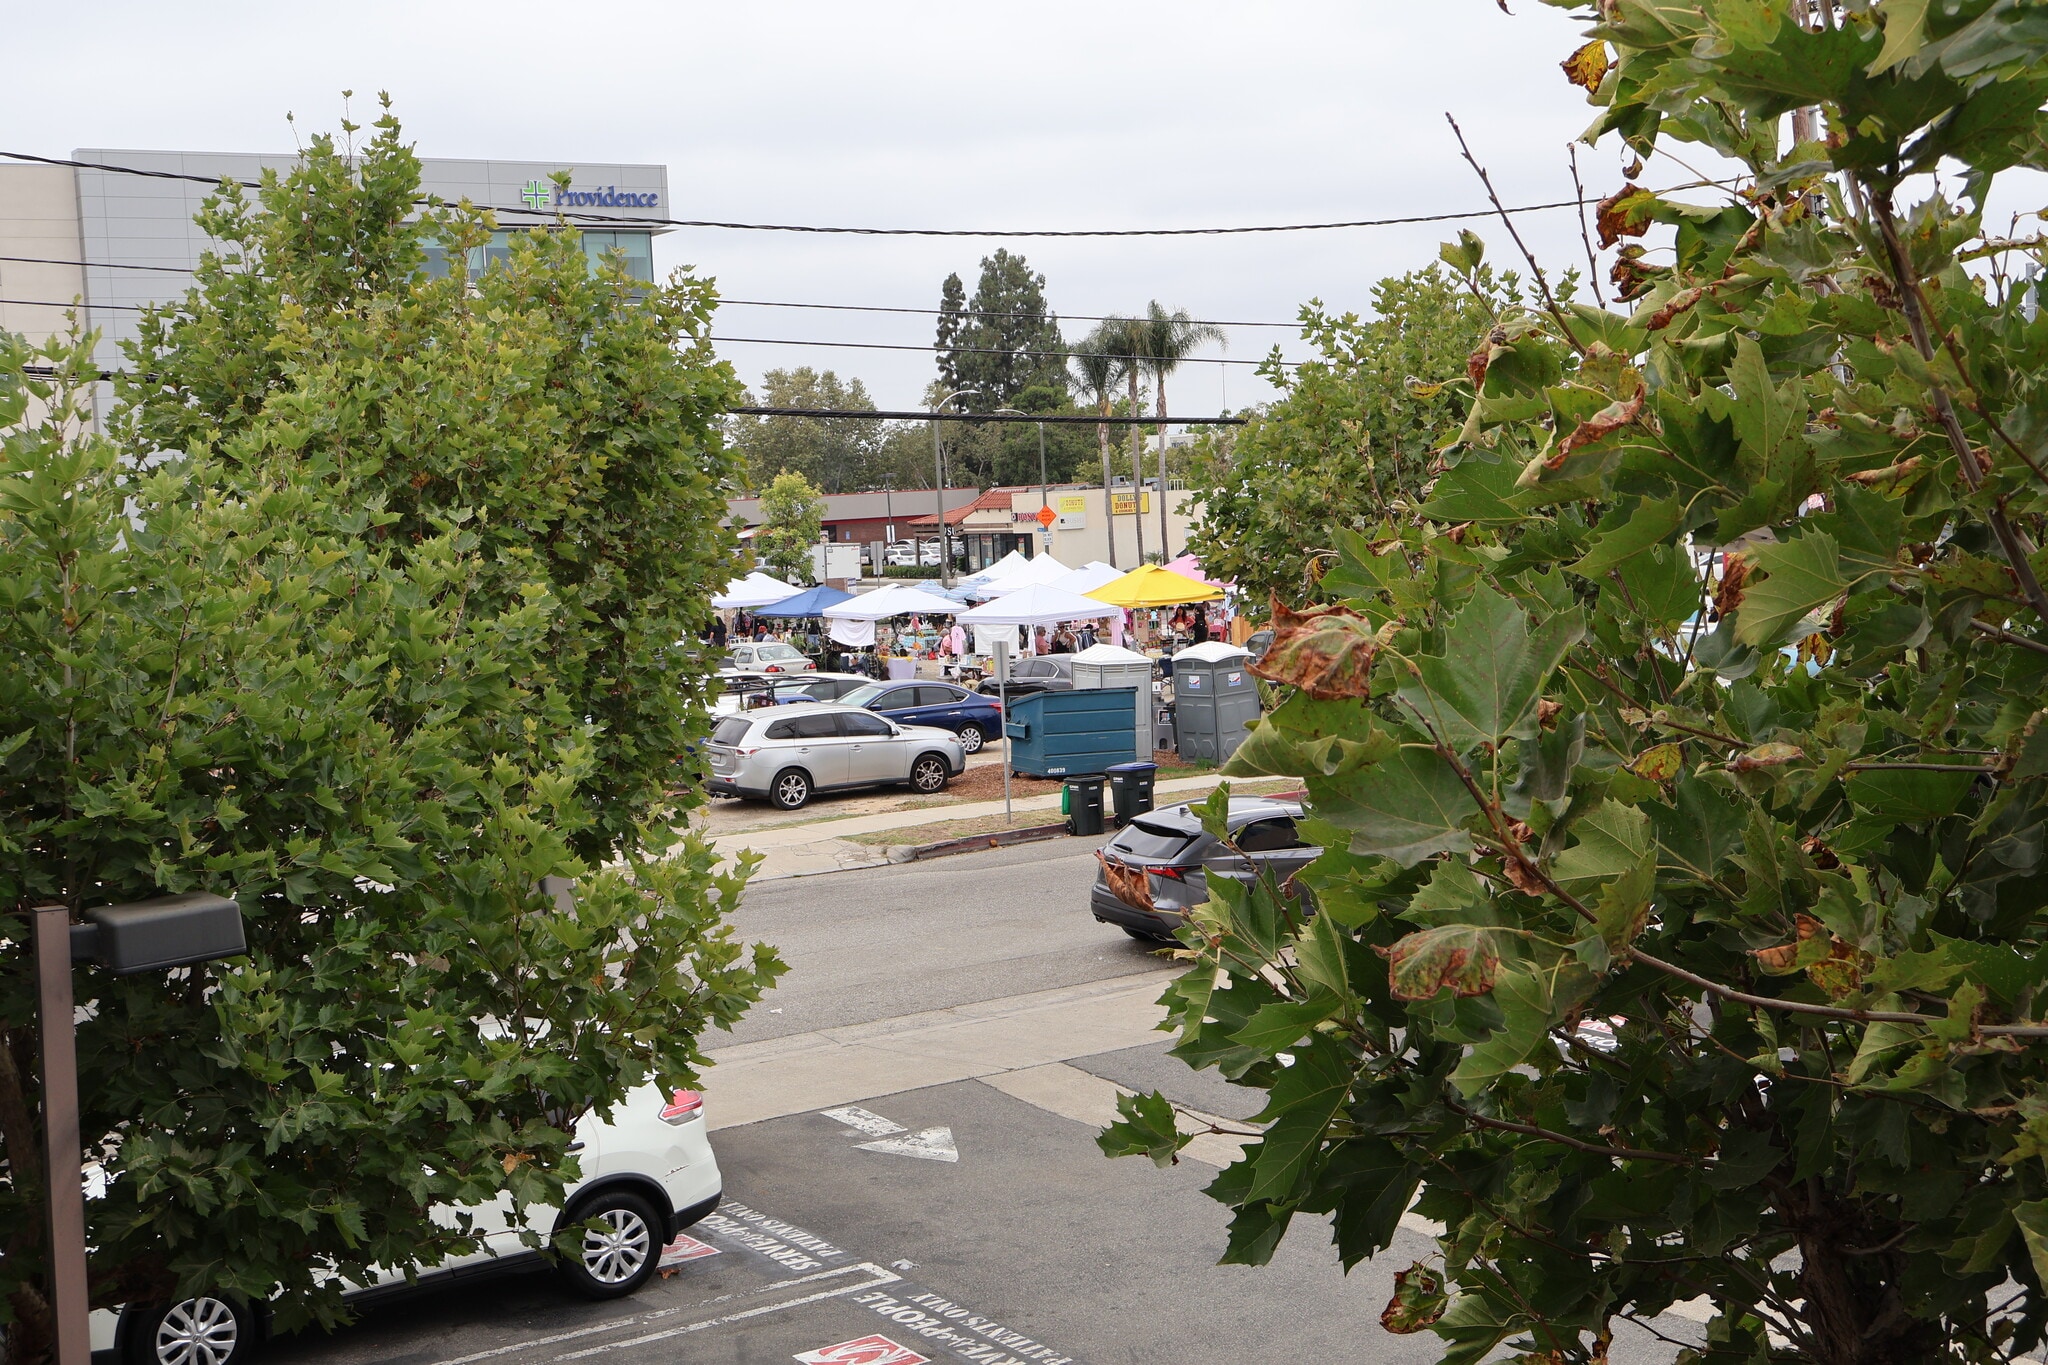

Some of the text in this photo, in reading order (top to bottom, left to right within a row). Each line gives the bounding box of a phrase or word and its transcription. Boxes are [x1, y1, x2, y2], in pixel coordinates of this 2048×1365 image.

[554, 185, 658, 208] Providence
[747, 1238, 822, 1271] SERVE
[762, 1219, 844, 1258] PATIENTS
[853, 1291, 955, 1339] PEOPLE
[906, 1292, 1074, 1365] PATIENTS ONLY
